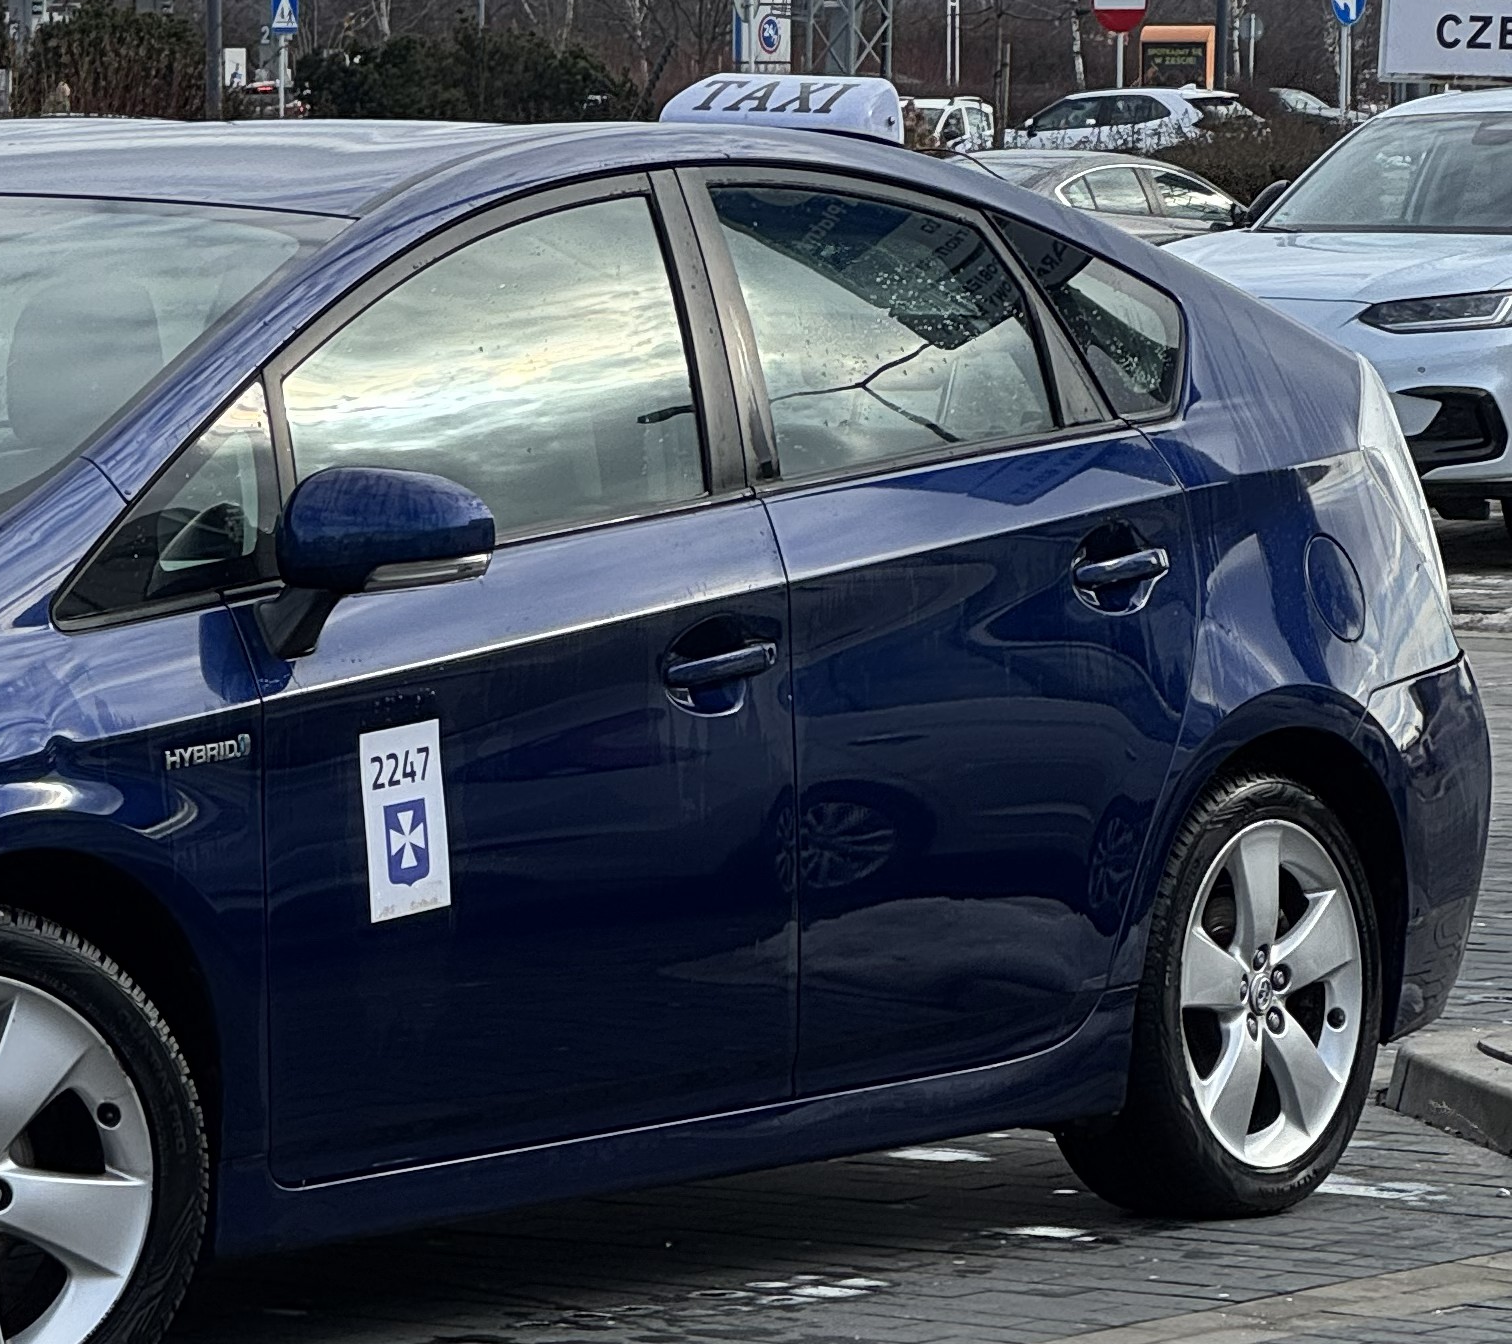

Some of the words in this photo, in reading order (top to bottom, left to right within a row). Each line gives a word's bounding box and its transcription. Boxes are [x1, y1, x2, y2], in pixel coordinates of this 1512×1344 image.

[260, 25, 270, 44] 2
[691, 80, 861, 114] TAXI
[164, 739, 239, 771] HYBRID
[369, 746, 430, 791] 2247
